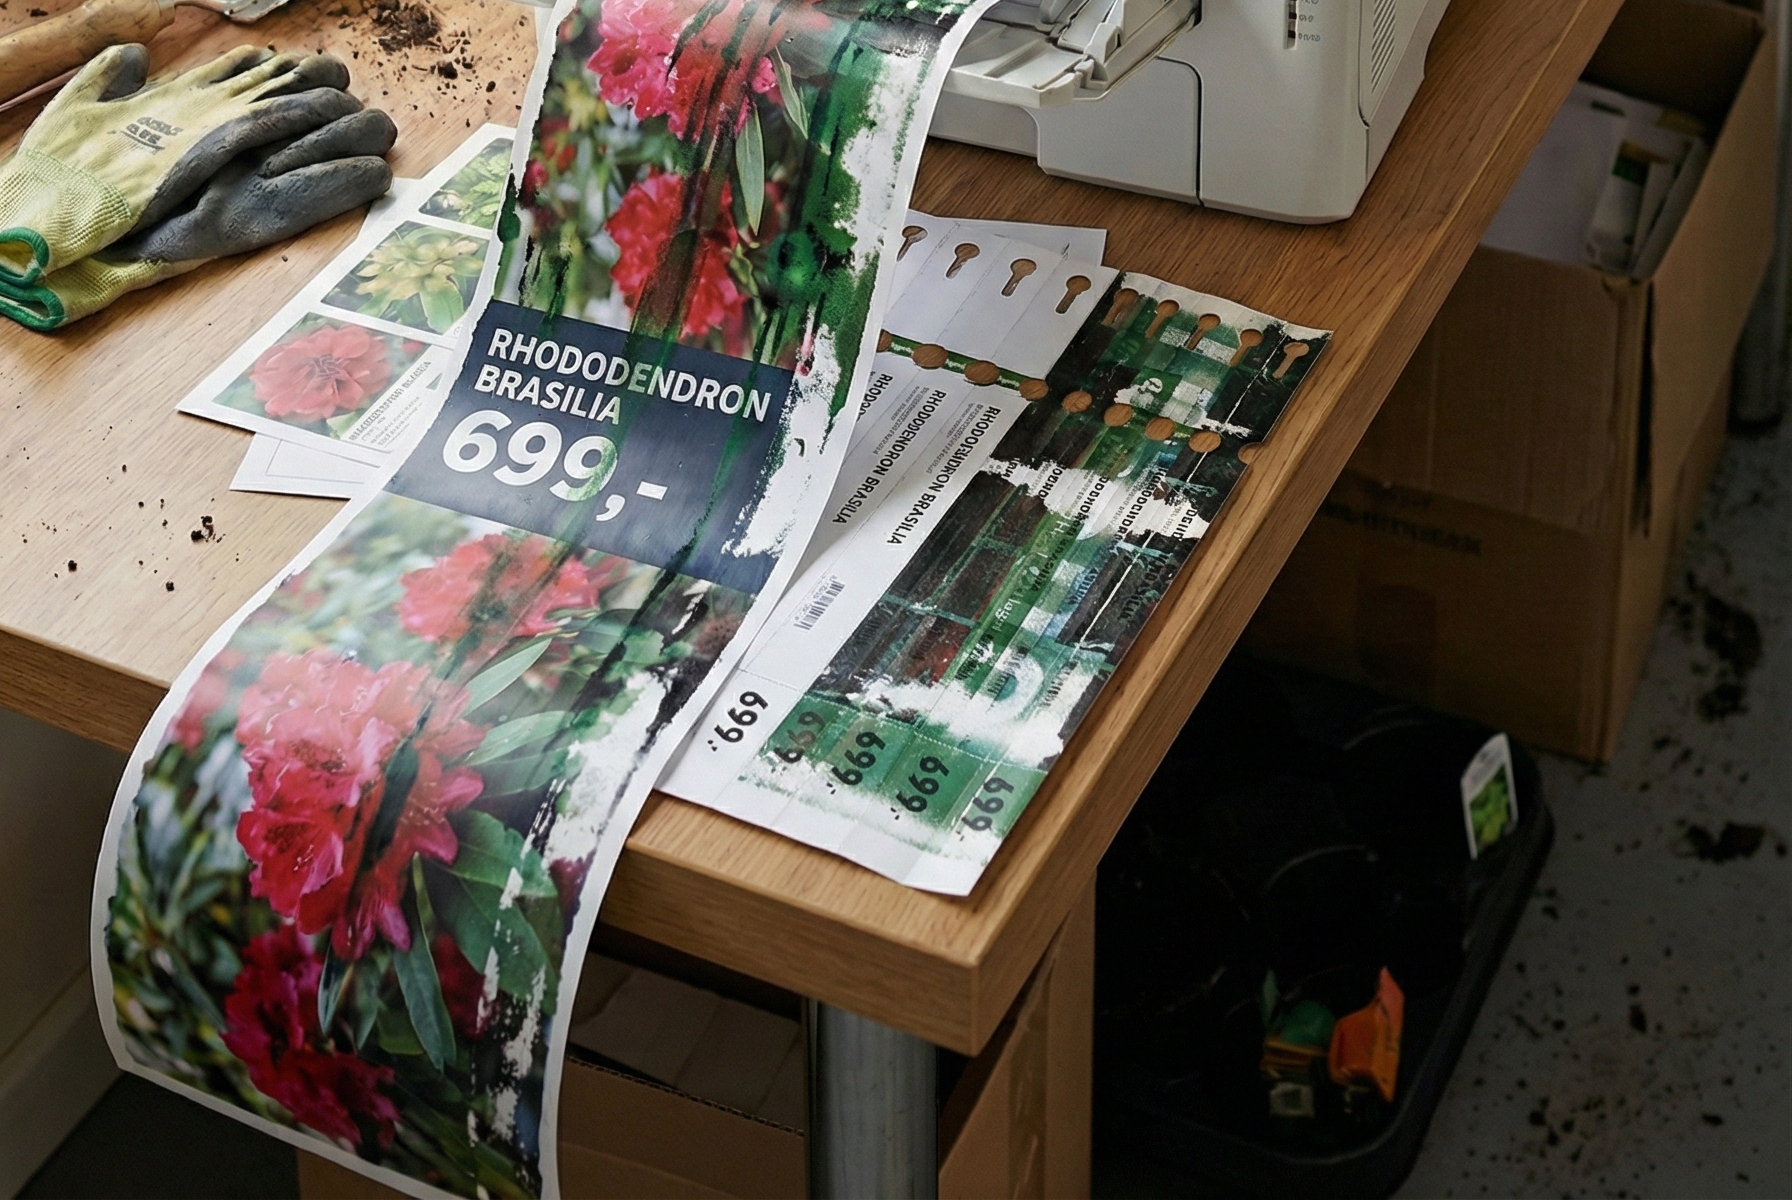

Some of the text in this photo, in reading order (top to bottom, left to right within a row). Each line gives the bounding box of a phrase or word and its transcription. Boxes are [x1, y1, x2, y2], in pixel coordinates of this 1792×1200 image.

[474, 363, 621, 425] BRASILIA
[487, 328, 772, 422] RHODODENDRON
[442, 408, 669, 522] 699,-
[887, 491, 936, 546] BRASILIA
